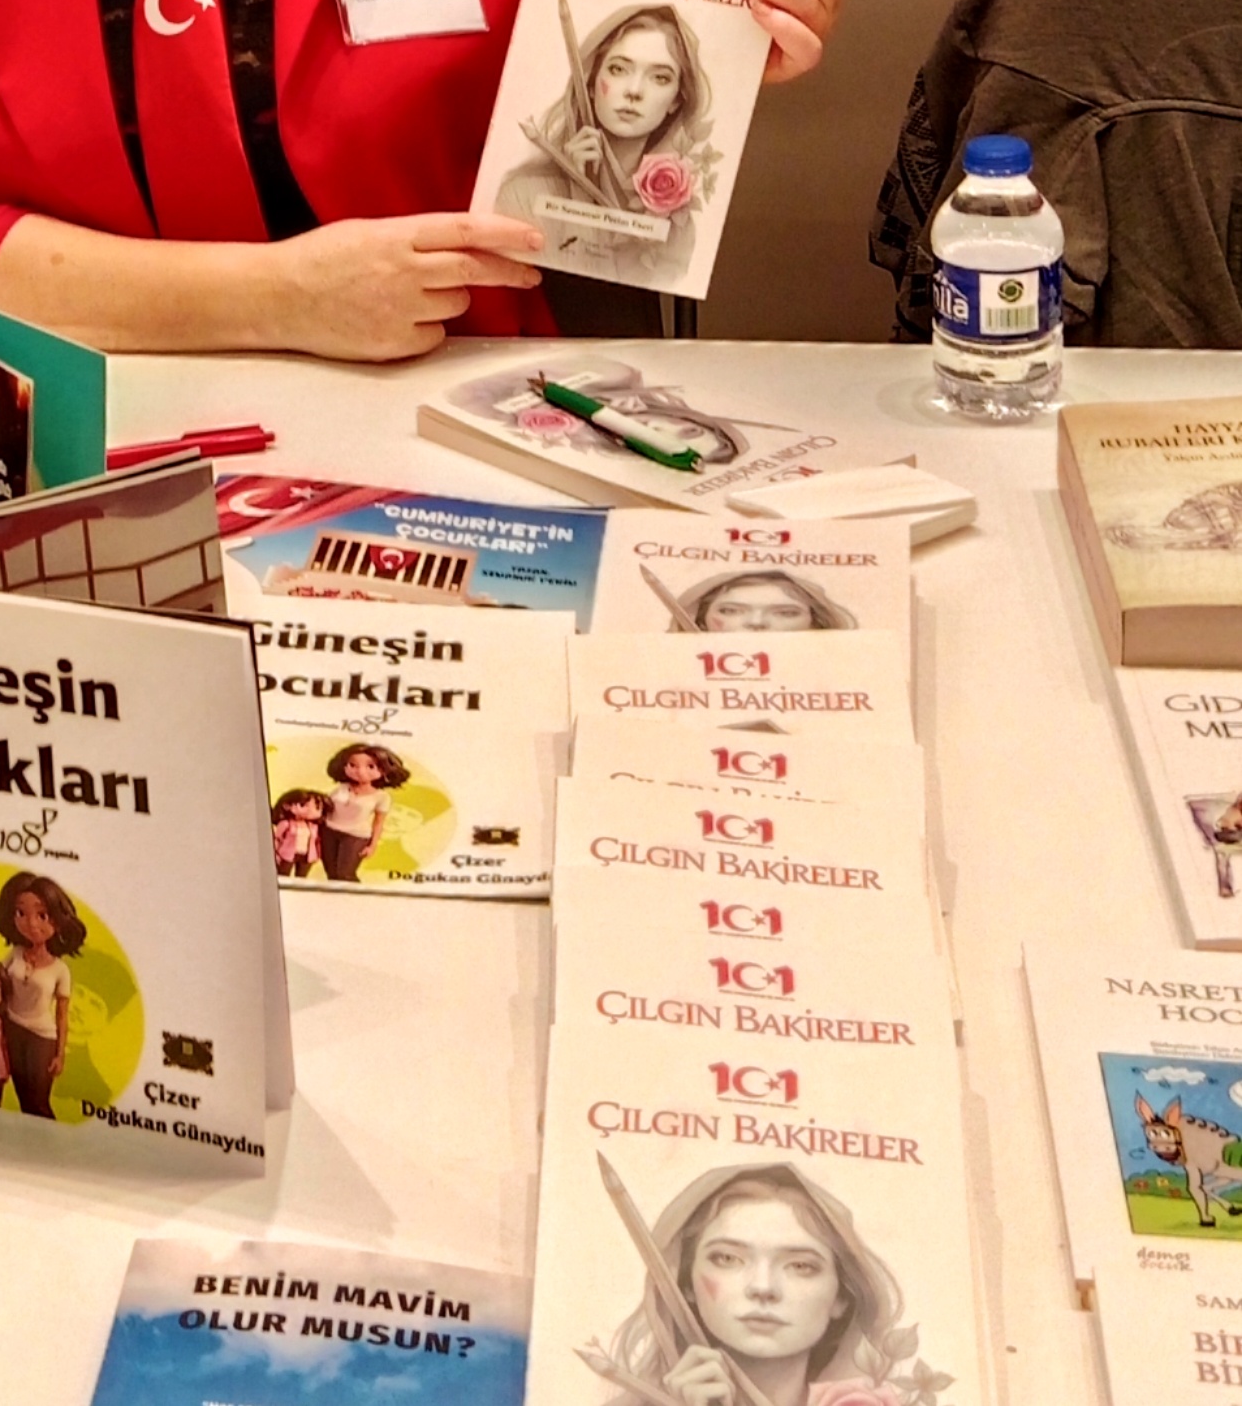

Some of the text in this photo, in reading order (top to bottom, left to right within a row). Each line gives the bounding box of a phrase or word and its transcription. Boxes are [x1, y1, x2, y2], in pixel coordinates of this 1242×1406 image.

[634, 541, 878, 567] ÇILGIN BAKİRELER
[257, 672, 481, 711] ocukları
[603, 685, 875, 713] ÇILGIN BAKİRELER
[388, 870, 552, 886] Doğukan Günayd
[451, 855, 506, 870] Çizer
[589, 836, 884, 891] ÇILGIN BAKİRELER
[596, 989, 916, 1046] ÇILGIN BAKİRELER
[144, 1081, 202, 1111] Çizer
[81, 1099, 267, 1159] Doğukan Günaydın
[587, 1101, 924, 1166] ÇILGIN BAKİRELER
[193, 1270, 471, 1322] BENİM MAVİM
[178, 1309, 477, 1359] OLUR MUSUN?
